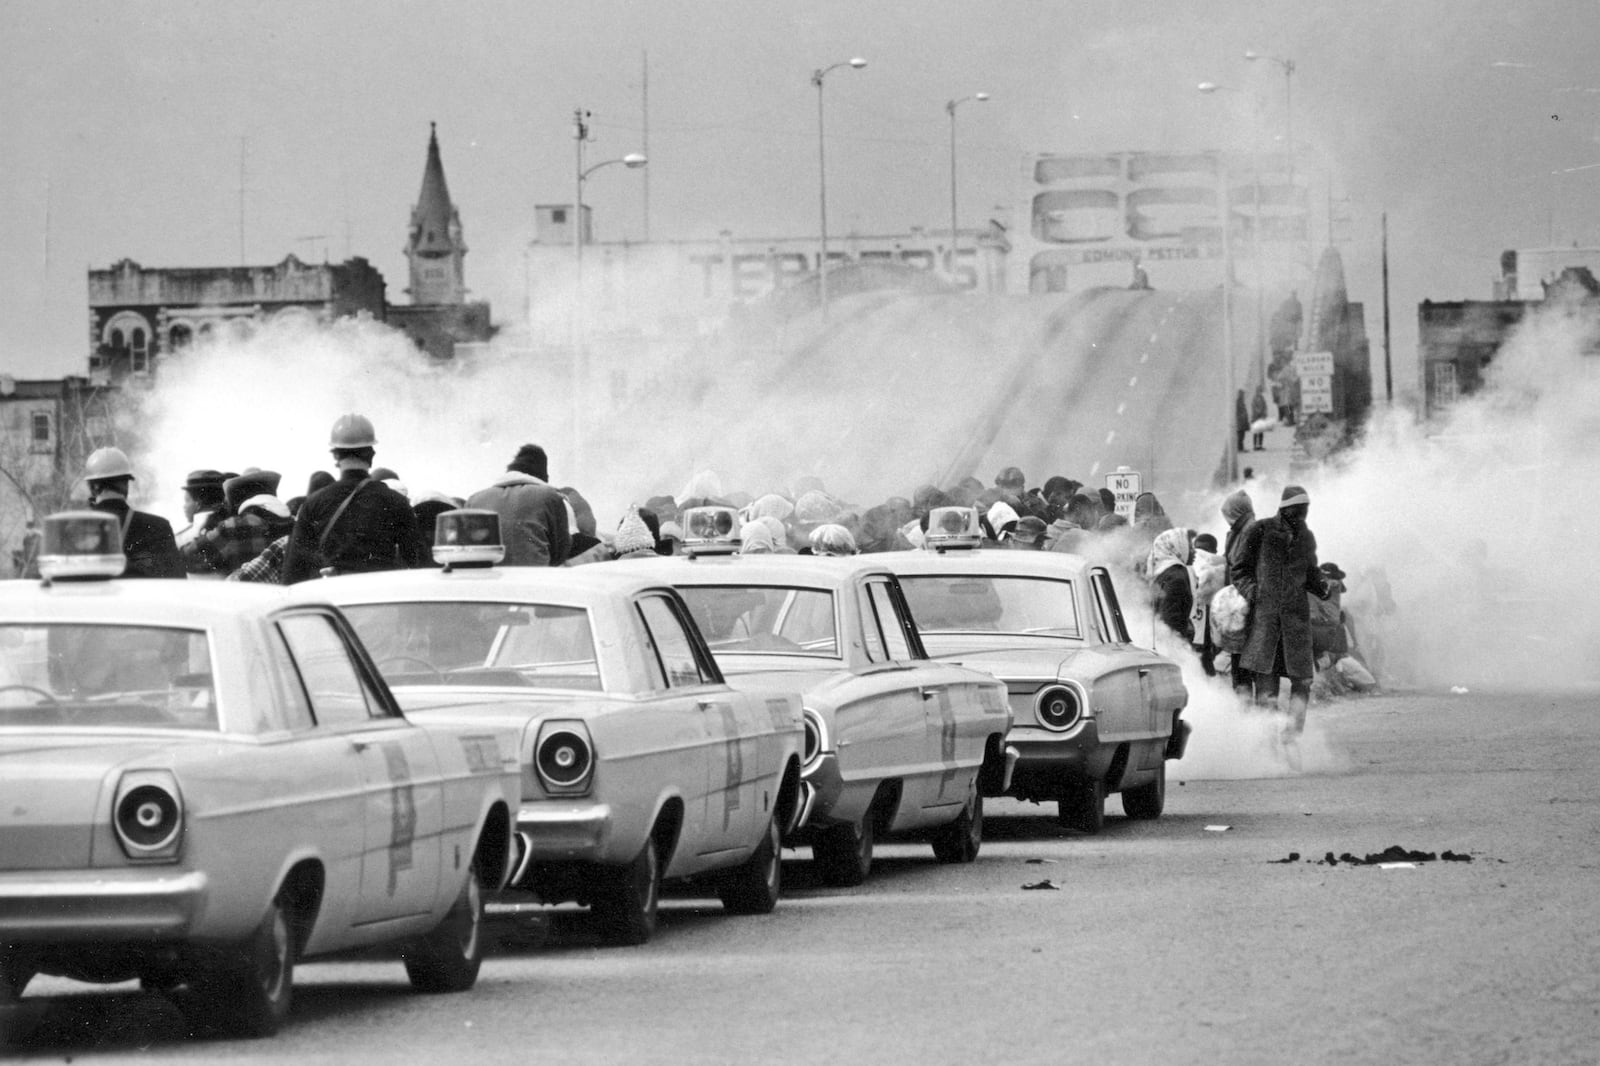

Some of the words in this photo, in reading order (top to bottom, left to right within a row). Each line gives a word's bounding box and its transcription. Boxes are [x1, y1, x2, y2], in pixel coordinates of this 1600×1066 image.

[689, 248, 977, 299] TEPPR'S
[1309, 377, 1323, 387] NO
[1116, 479, 1129, 489] NO
[1116, 493, 1138, 502] RKIN
[1115, 505, 1129, 513] ANY
